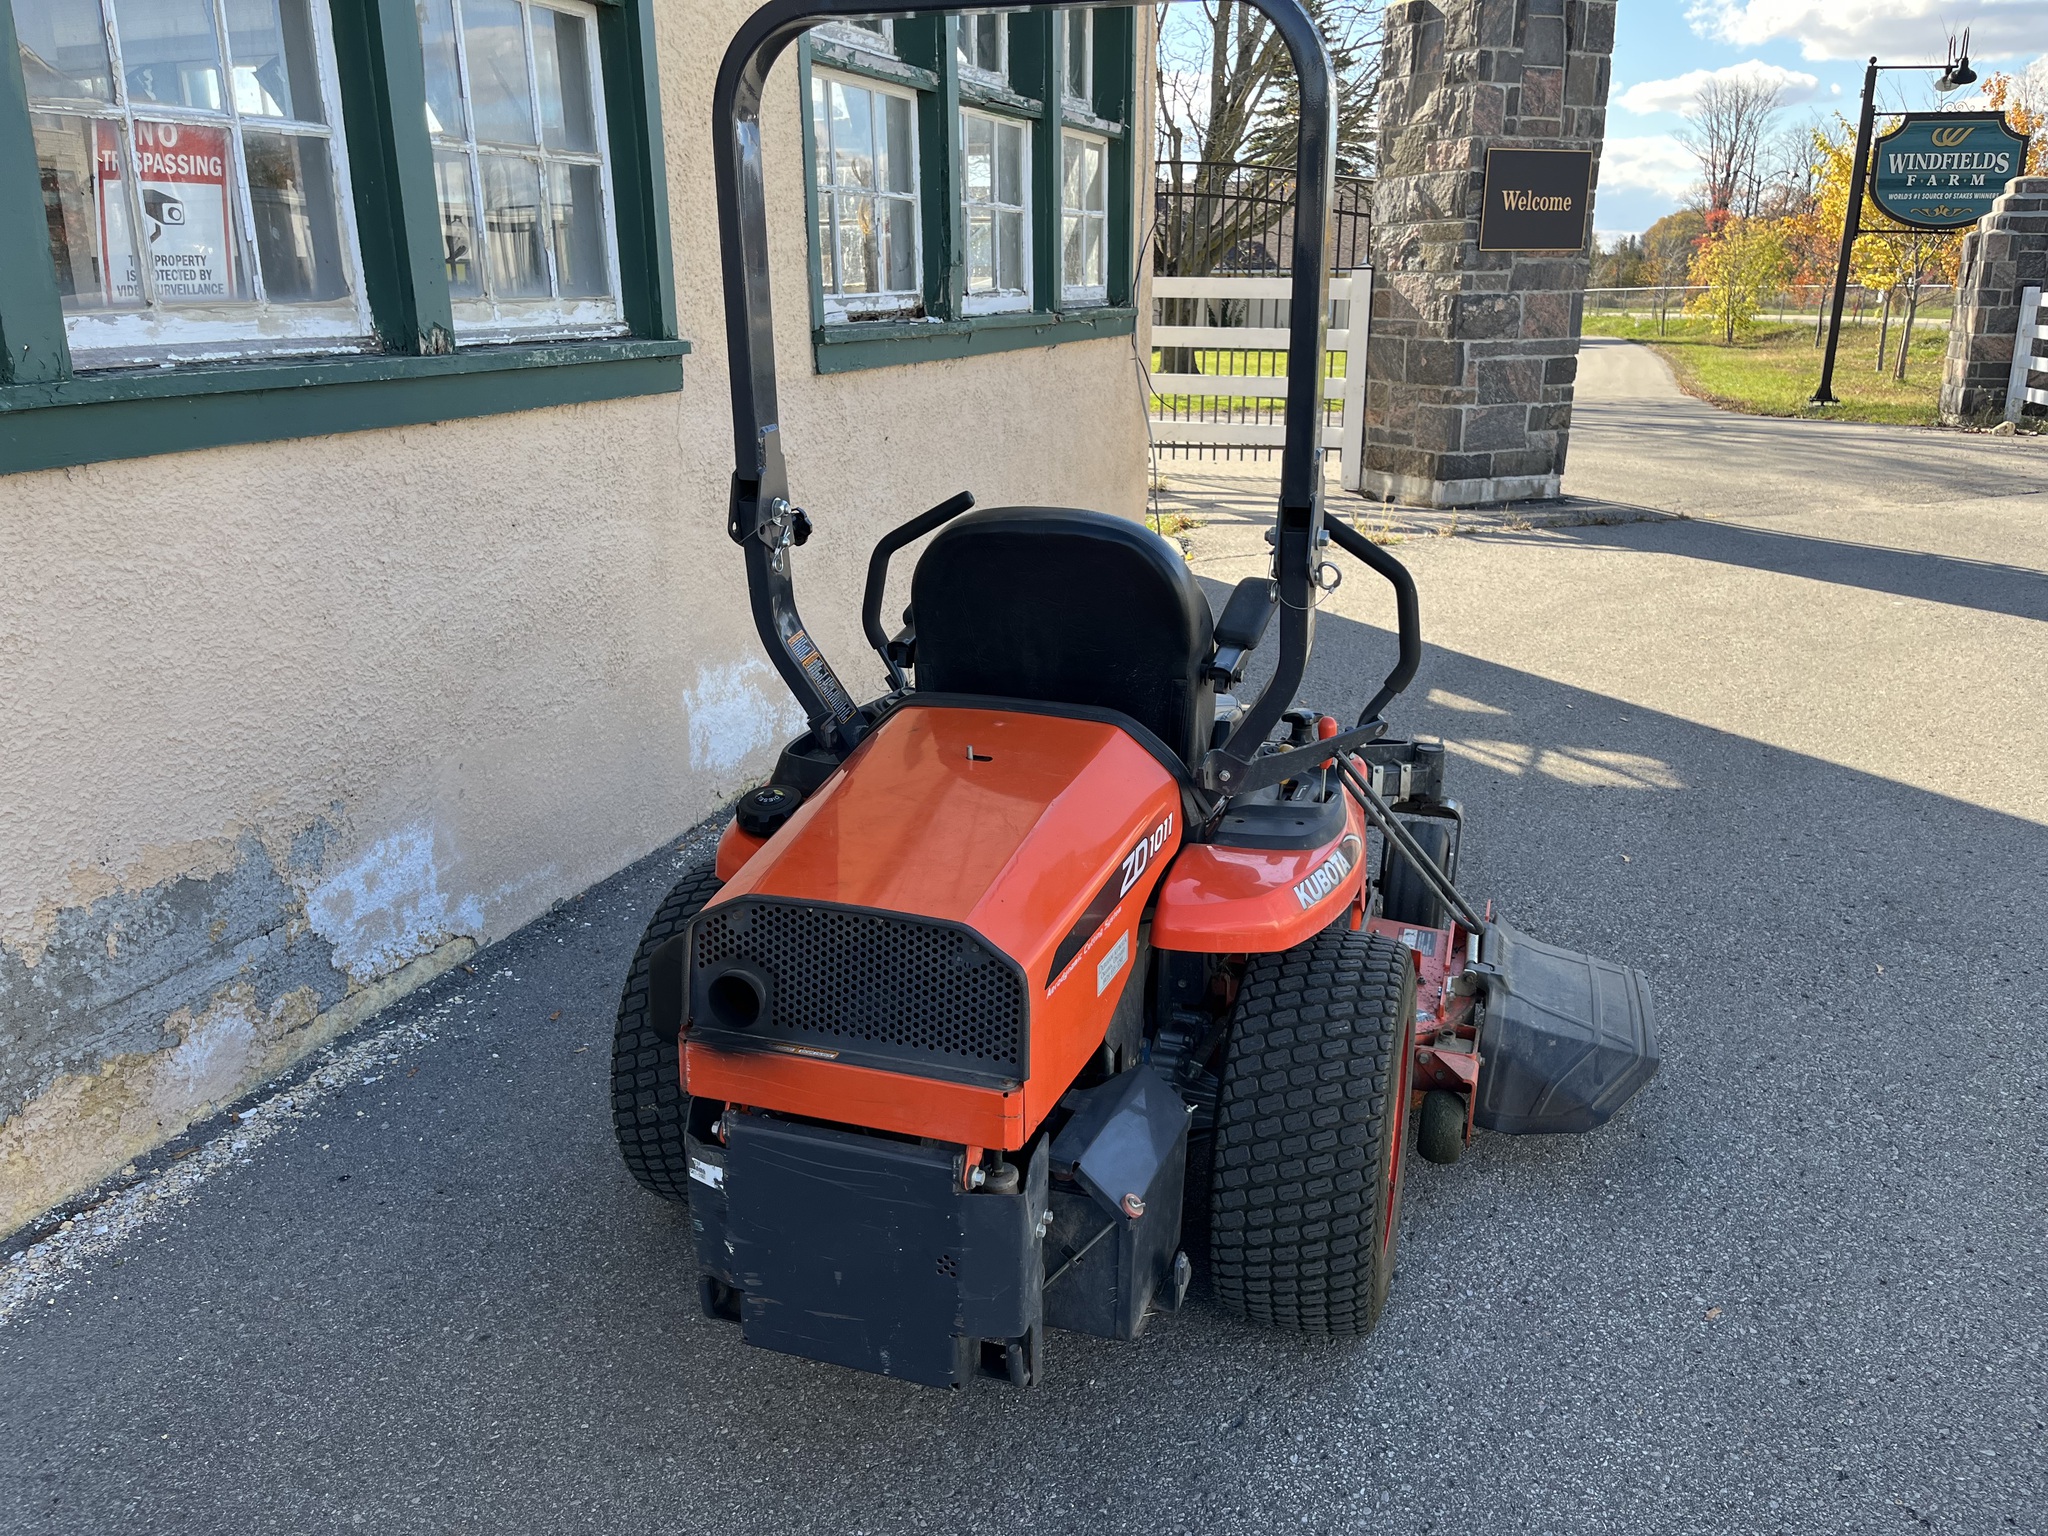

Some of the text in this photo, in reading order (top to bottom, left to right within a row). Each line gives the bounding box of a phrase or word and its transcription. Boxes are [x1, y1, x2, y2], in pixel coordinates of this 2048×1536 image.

[138, 122, 178, 148] NO
[101, 149, 223, 177] TRSPASSING
[1888, 152, 2010, 174] WINDFIELDS
[1501, 189, 1572, 211] Welcome
[154, 254, 207, 267] PROPERTY
[126, 269, 137, 282] IS
[199, 269, 213, 281] BY
[116, 283, 224, 297] VIDE URVEILLANCE
[1293, 850, 1352, 910] KUBOTA
